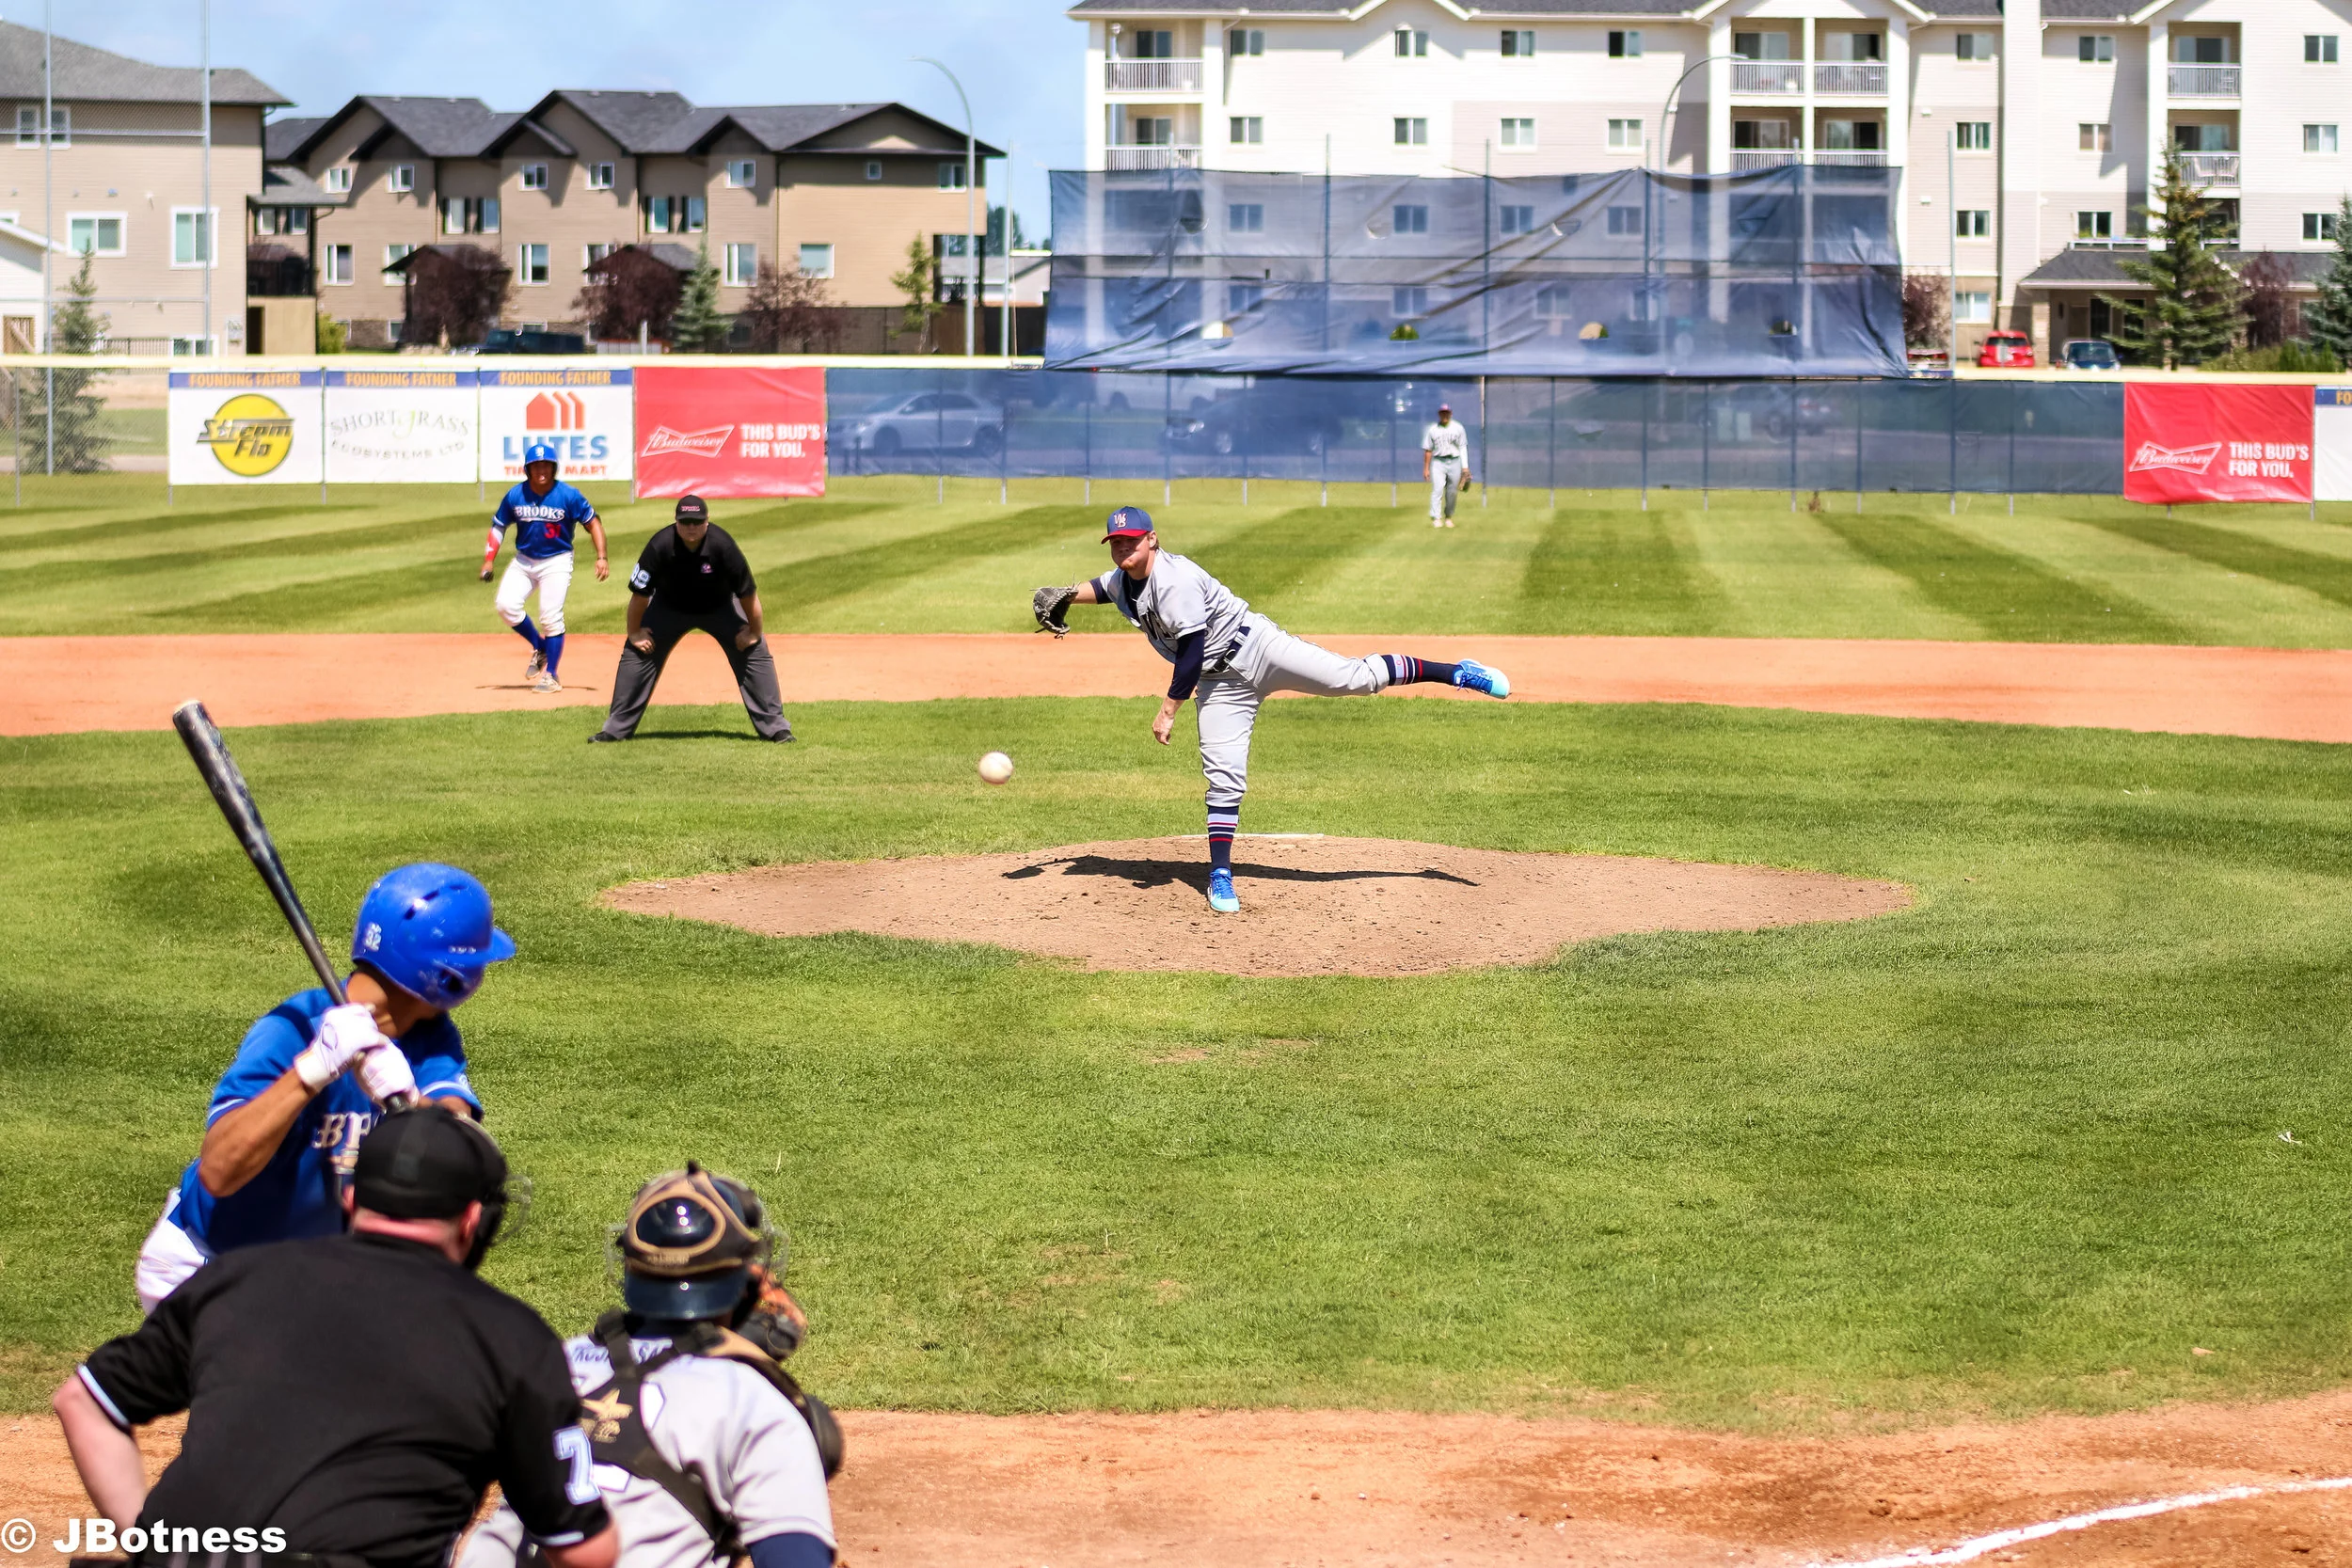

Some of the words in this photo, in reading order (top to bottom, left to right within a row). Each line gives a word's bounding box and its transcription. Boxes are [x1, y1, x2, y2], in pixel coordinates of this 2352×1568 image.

[189, 372, 254, 388] FOUNDING
[255, 372, 300, 387] FATHER
[345, 372, 409, 387] FOUNDING
[411, 372, 457, 387] FATHER
[500, 371, 564, 386] FOUNDING
[565, 371, 612, 386] FATHER
[649, 428, 723, 449] Budweiser
[740, 424, 773, 440] THIS
[777, 424, 821, 440] BUD'S
[740, 442, 770, 458] FOR
[772, 442, 806, 458] YOU.
[2137, 447, 2212, 467] Budweiser
[2229, 442, 2262, 459] THIS
[2265, 444, 2310, 461] BUD'S
[2229, 460, 2258, 477] FOR
[2261, 461, 2295, 479] YOU.
[515, 505, 565, 521] BROOKS
[553, 1425, 601, 1505] 7
